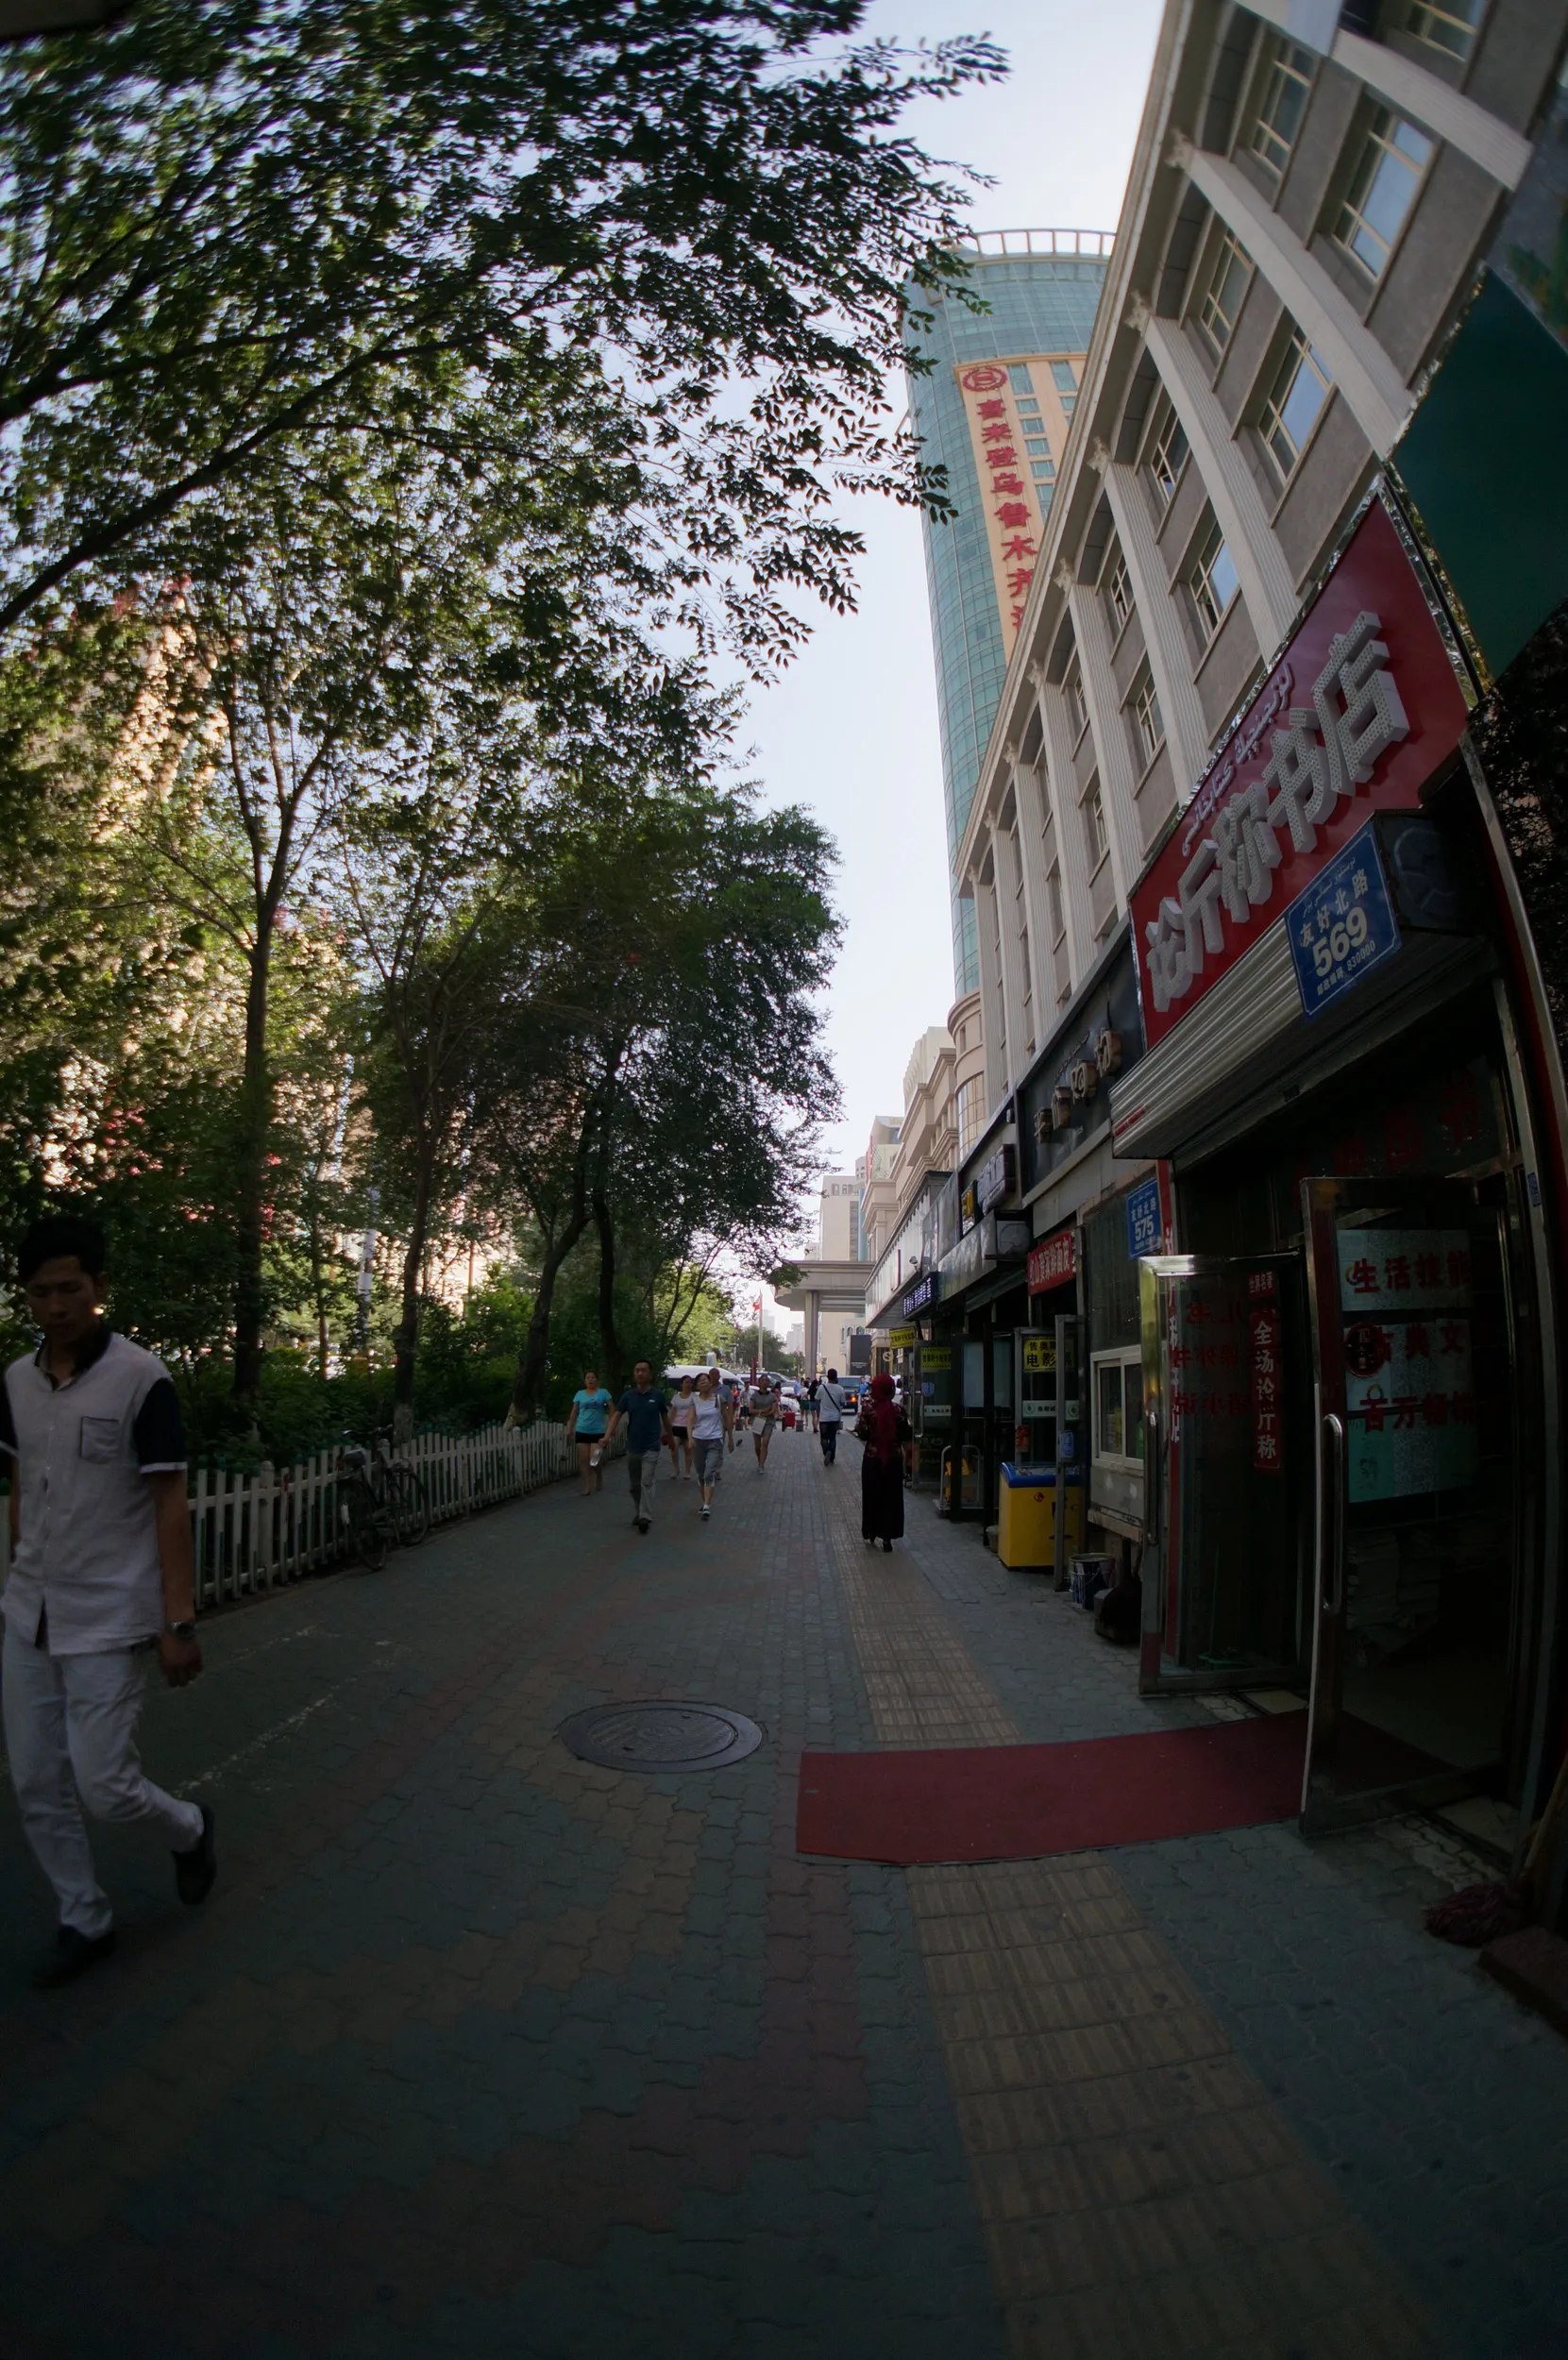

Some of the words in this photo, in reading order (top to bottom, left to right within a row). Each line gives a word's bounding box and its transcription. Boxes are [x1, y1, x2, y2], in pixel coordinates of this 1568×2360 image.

[976, 398, 1037, 632] 喜来登乌鲁木齐
[1299, 868, 1370, 949] 友好北路
[1311, 906, 1368, 978] 569
[1346, 939, 1376, 971] 830000
[1130, 1196, 1157, 1222] 友好北路
[1134, 1213, 1155, 1242] 575
[1352, 1250, 1473, 1294] 生活技能
[1028, 1340, 1056, 1353] 售奥斯
[1253, 1319, 1276, 1460] 全场论斤称
